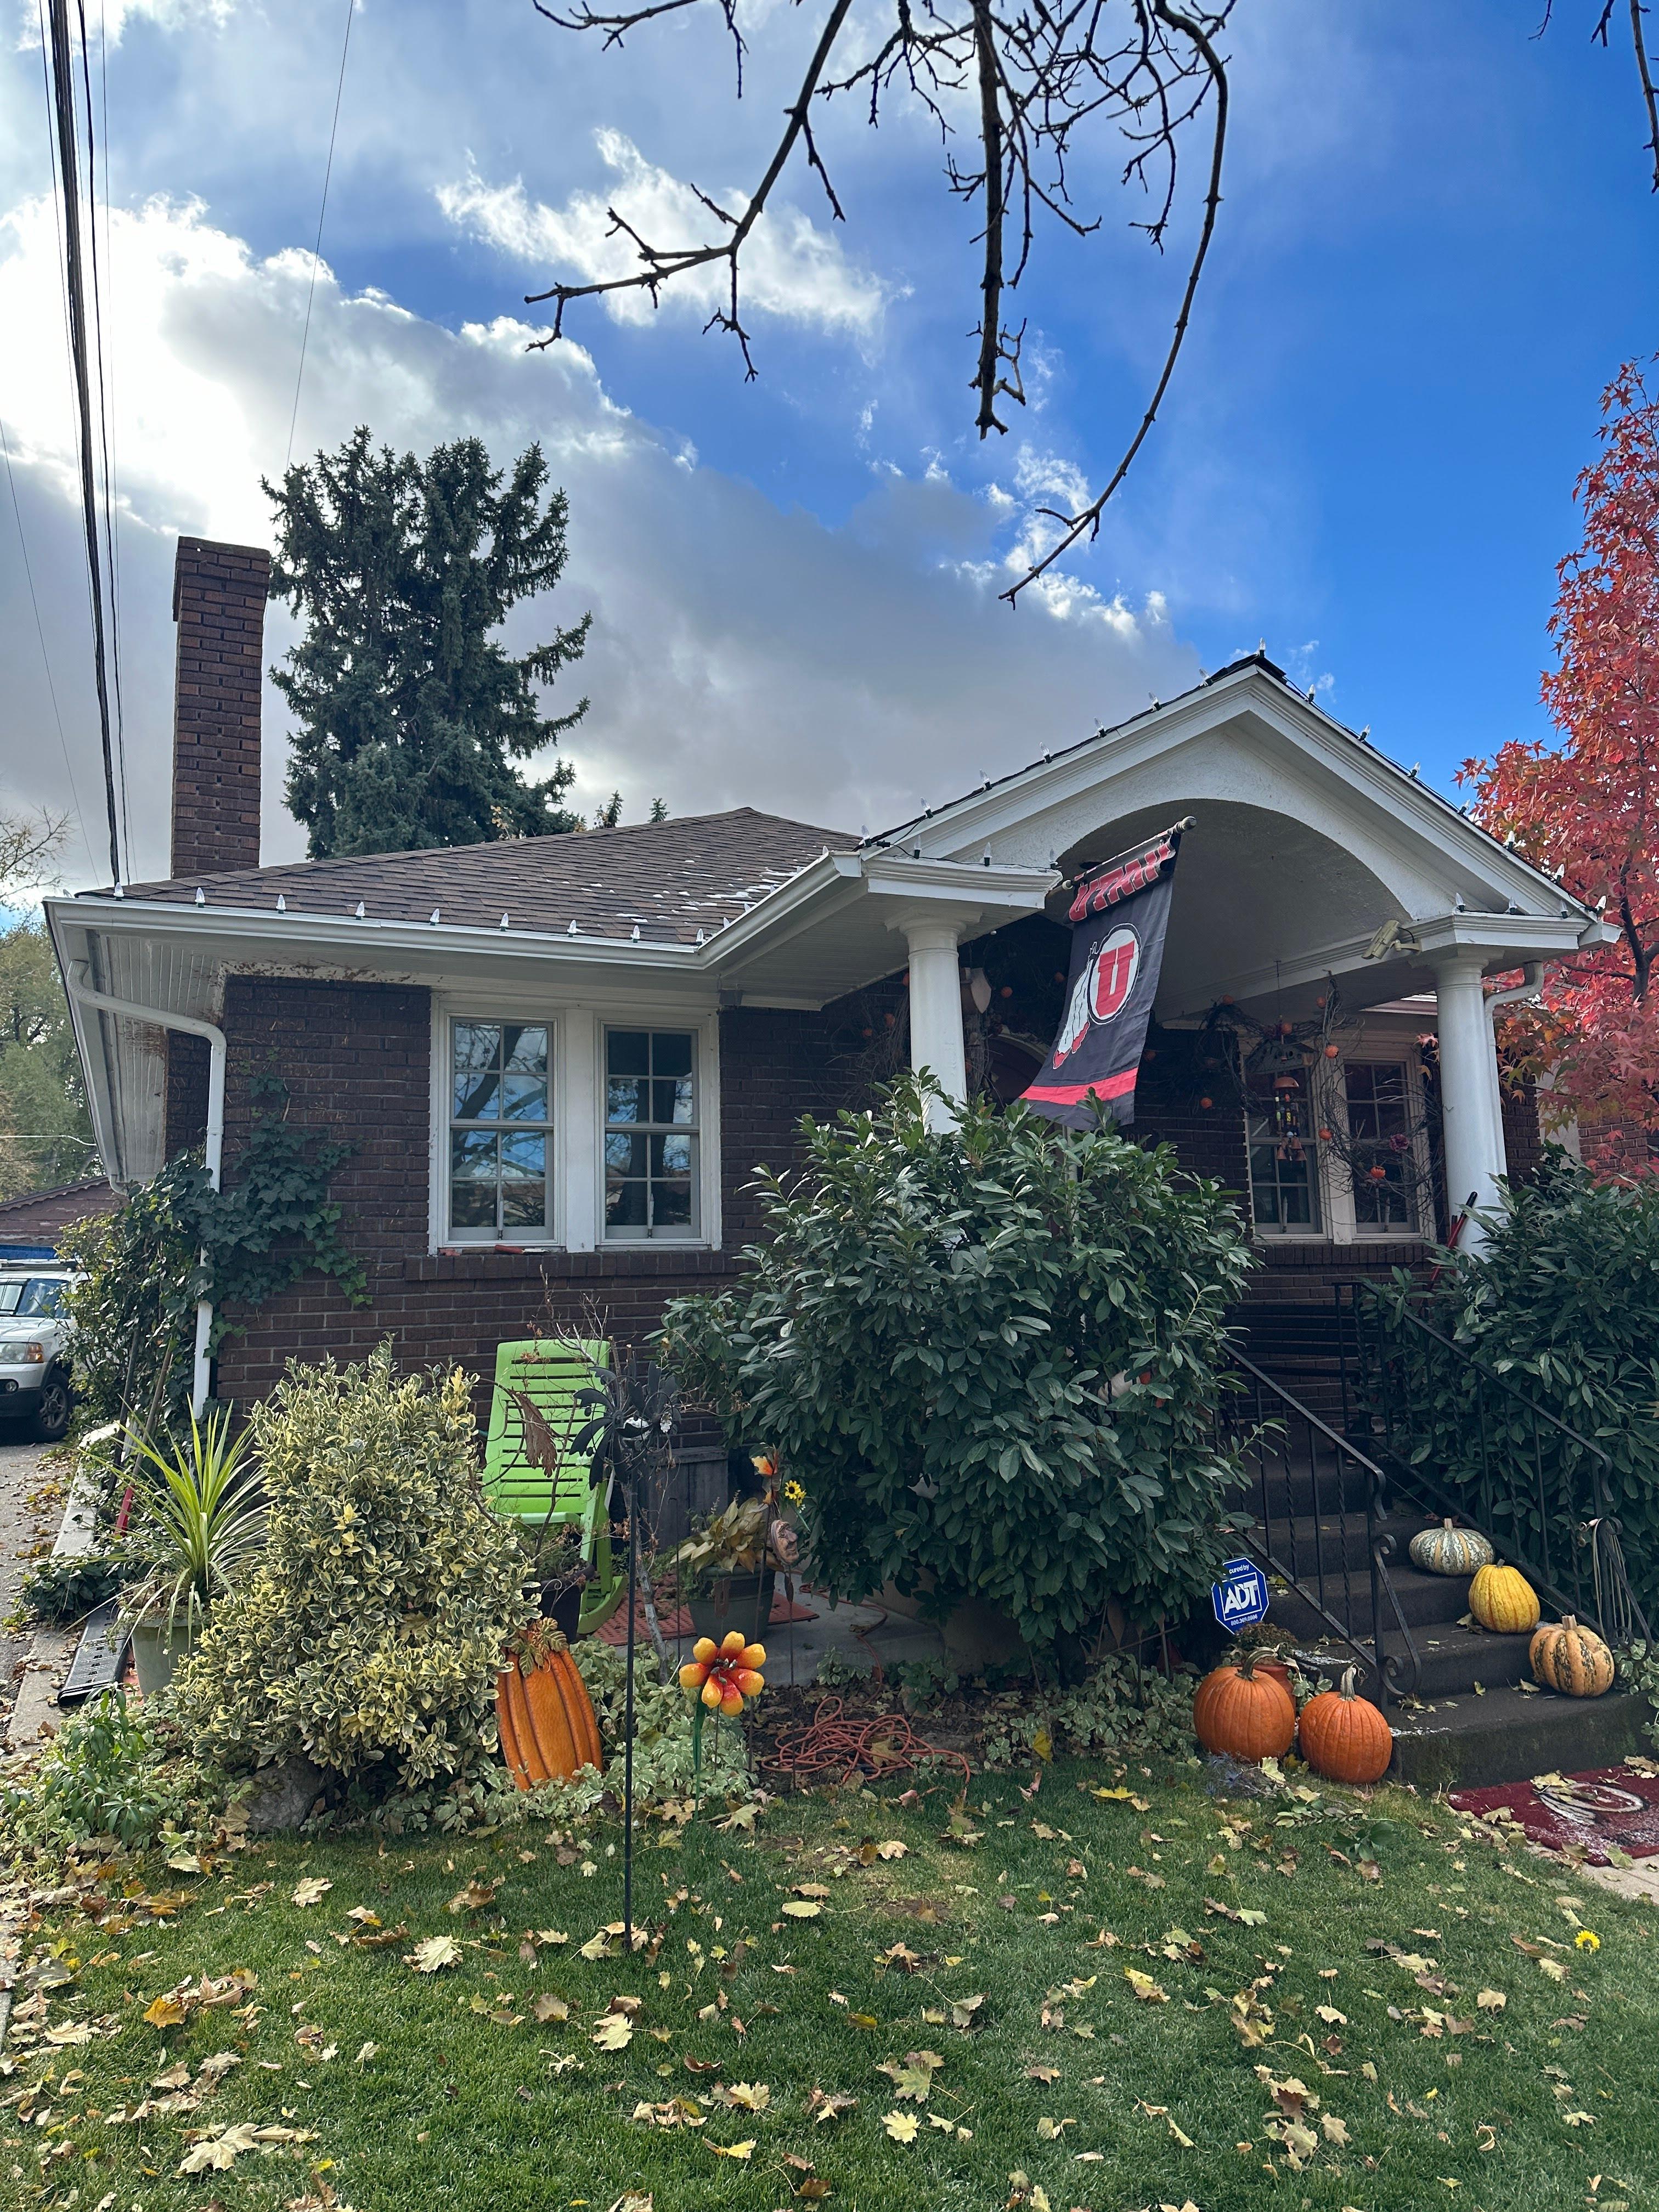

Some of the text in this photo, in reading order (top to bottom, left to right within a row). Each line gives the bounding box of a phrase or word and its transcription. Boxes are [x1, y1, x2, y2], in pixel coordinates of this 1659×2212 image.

[1069, 843, 1171, 922] UTAH
[1096, 940, 1135, 1018] U
[1224, 1579, 1257, 1614] ADT
